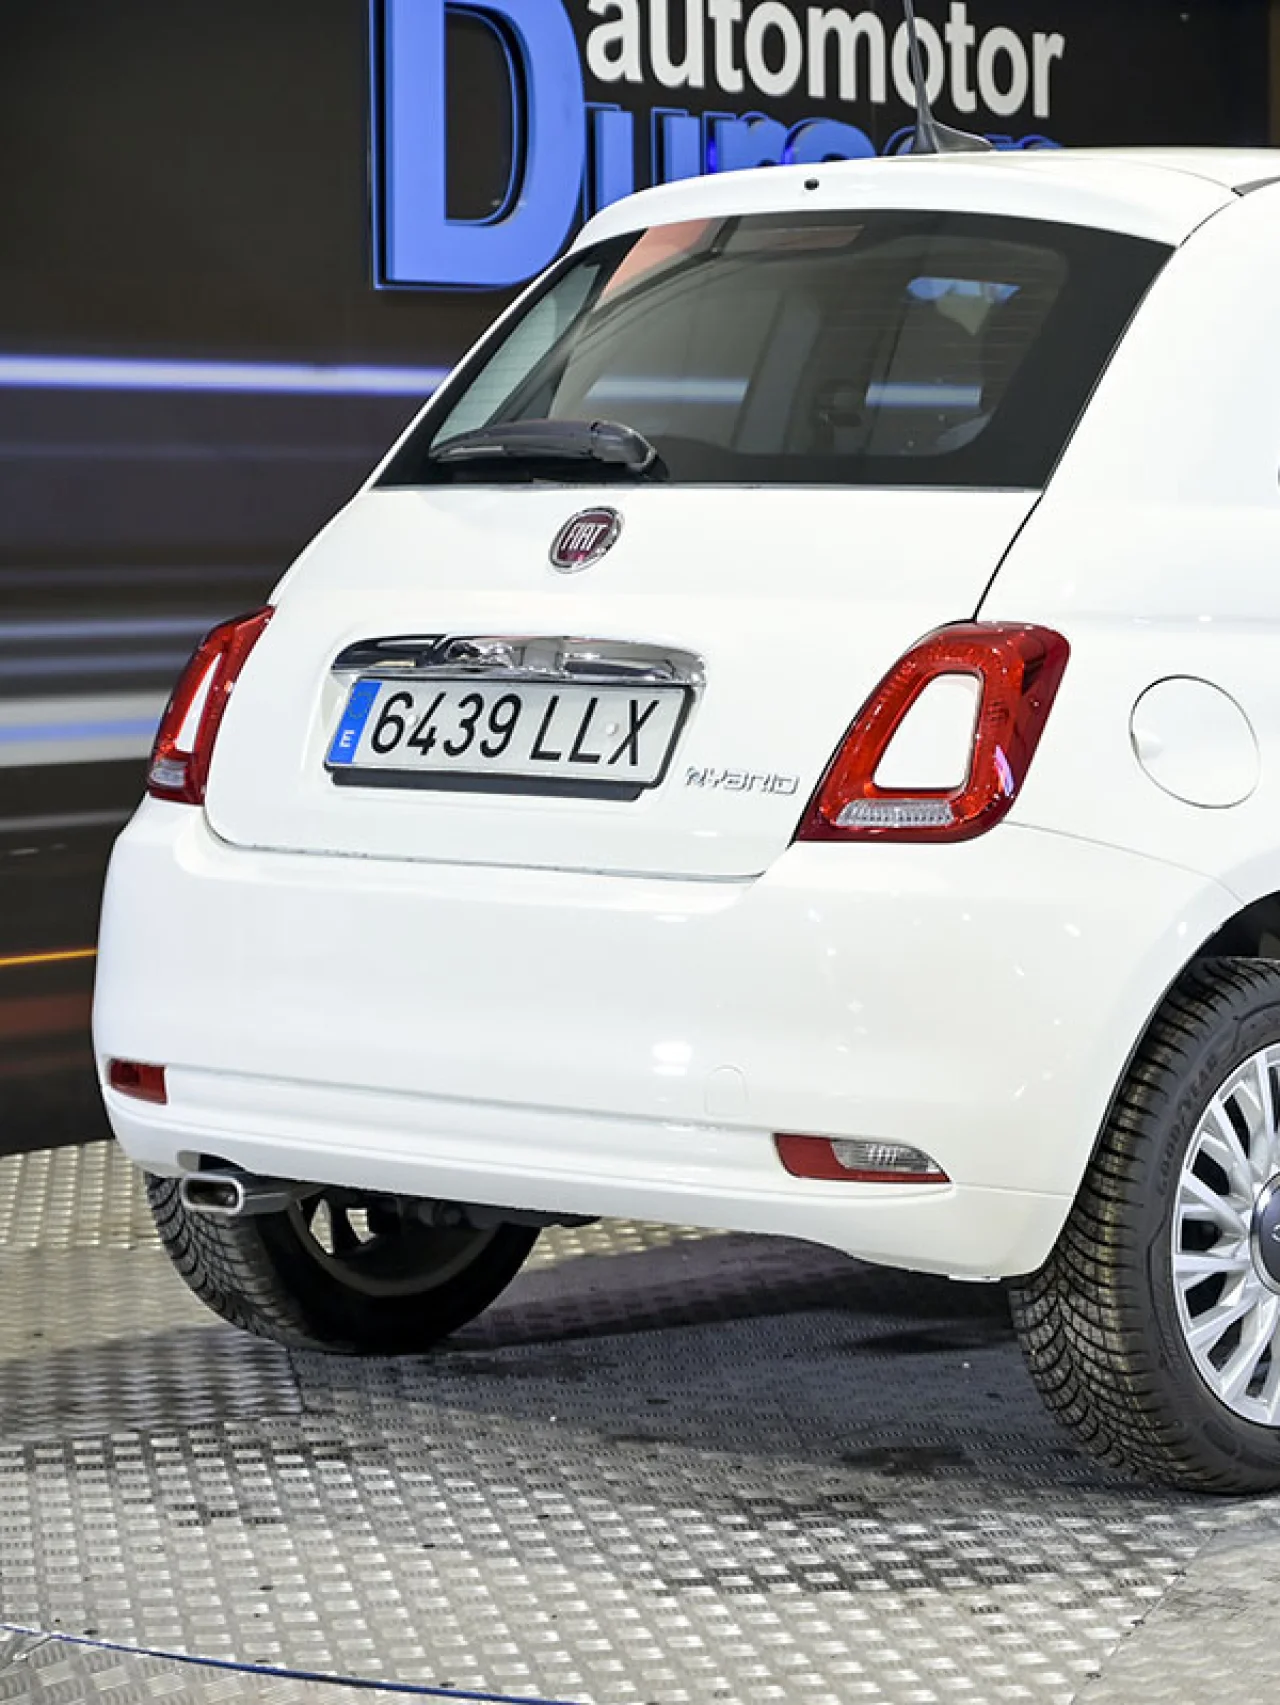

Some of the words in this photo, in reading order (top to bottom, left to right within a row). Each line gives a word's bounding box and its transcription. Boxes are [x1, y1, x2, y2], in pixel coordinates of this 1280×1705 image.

[586, 0, 1065, 118] automotor
[558, 522, 609, 551] FIAT
[340, 729, 355, 748] E
[370, 690, 522, 758] 6439
[528, 694, 660, 767] LLX
